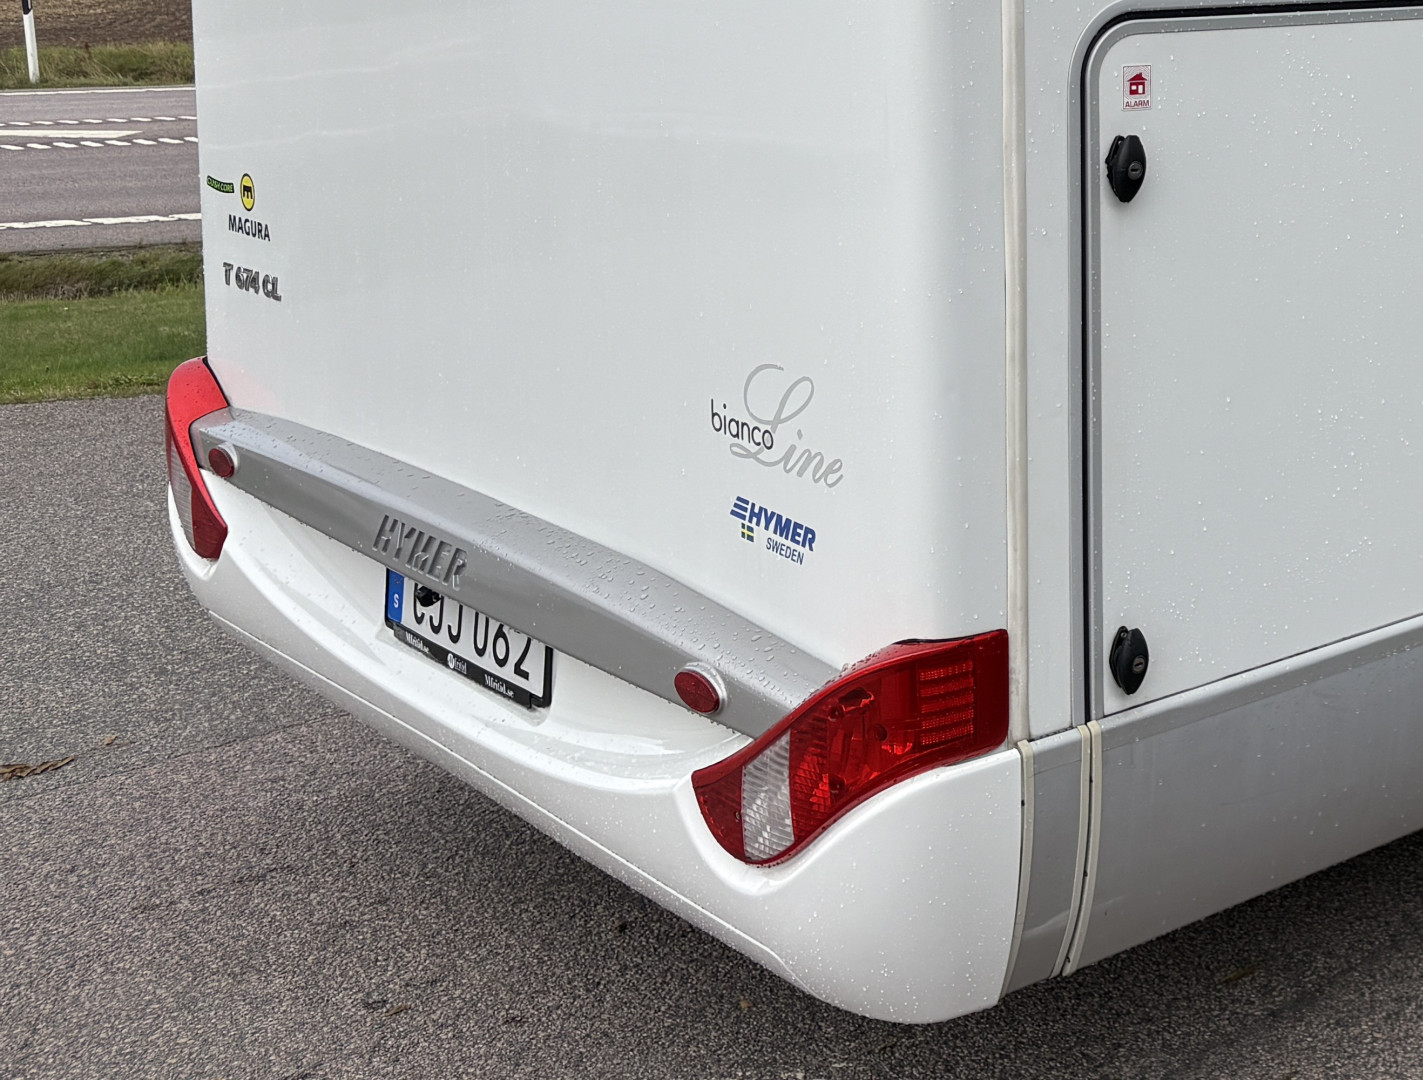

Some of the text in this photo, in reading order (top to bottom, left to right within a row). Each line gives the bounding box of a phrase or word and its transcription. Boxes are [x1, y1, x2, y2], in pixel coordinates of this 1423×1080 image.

[1124, 100, 1150, 108] ALARM
[228, 214, 271, 242] MAGURA
[223, 262, 282, 302] T 674 CL
[710, 363, 844, 488] bianco Line
[748, 502, 817, 552] HYMER
[372, 514, 468, 591] HYMER
[765, 537, 805, 566] SWEDEN
[393, 593, 400, 609] S
[473, 610, 531, 682] 062
